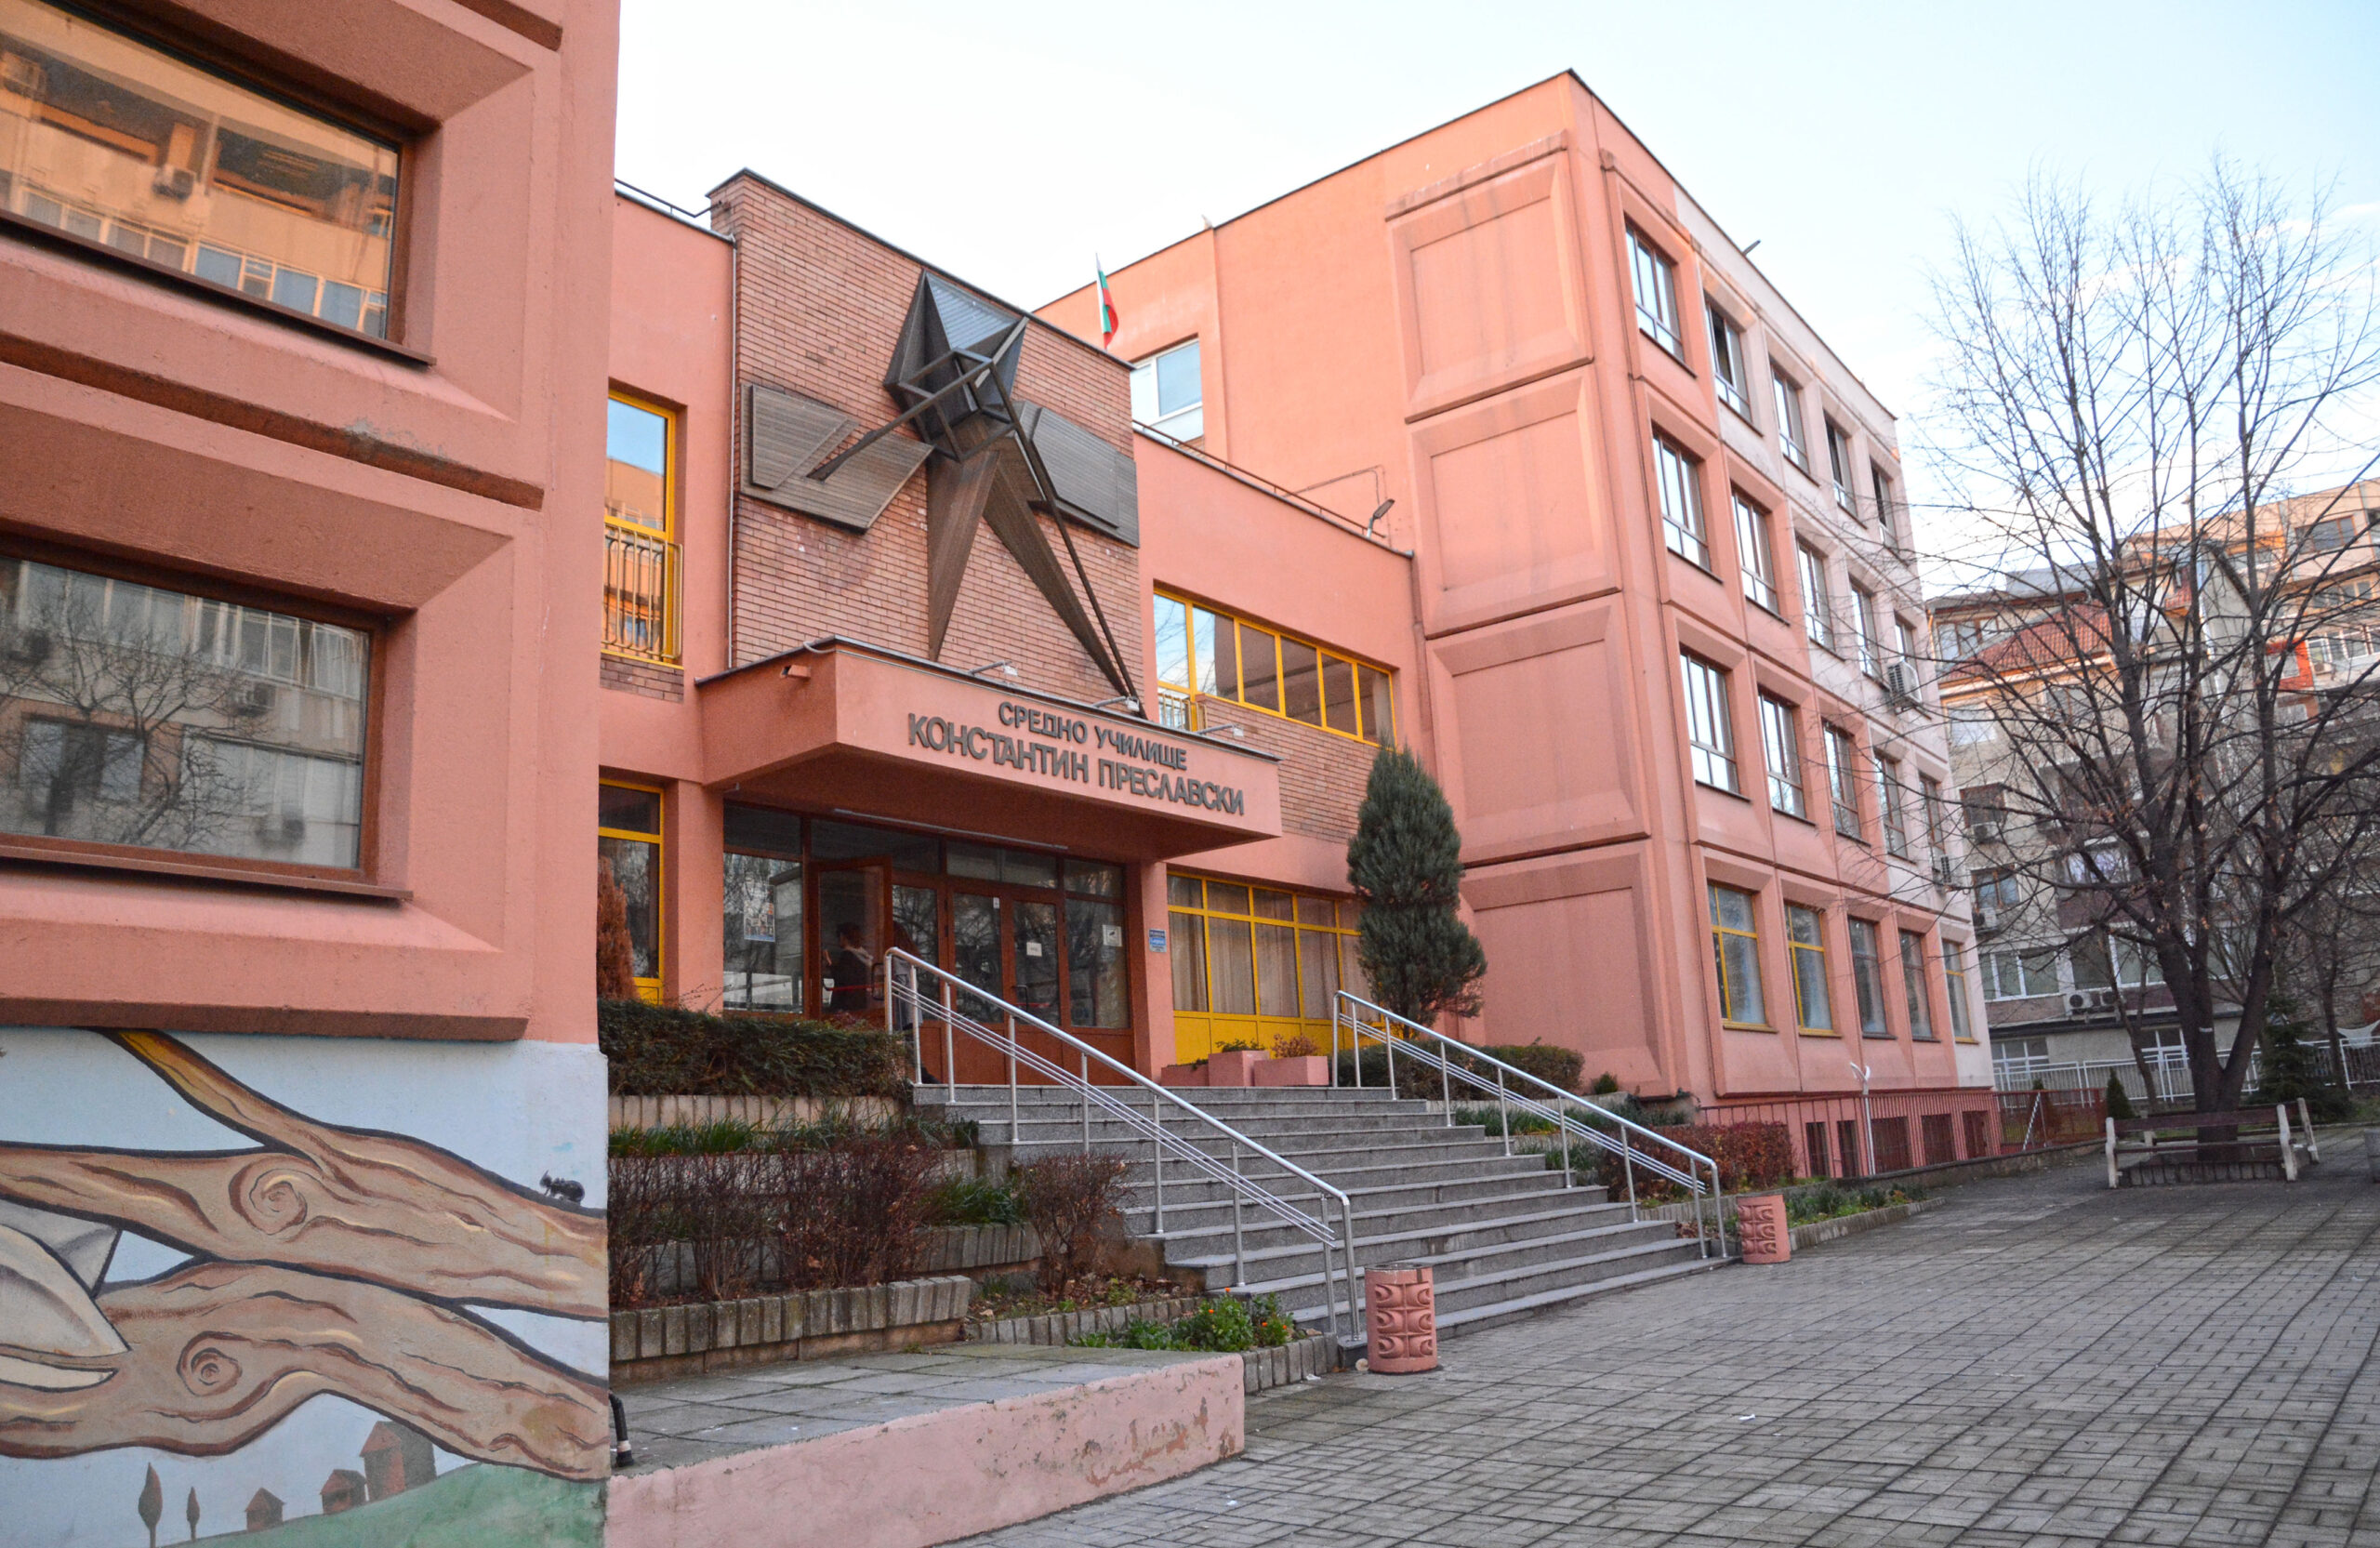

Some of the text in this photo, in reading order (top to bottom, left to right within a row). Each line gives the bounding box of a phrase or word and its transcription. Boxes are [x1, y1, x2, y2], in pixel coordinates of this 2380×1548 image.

[908, 712, 1245, 815] КОНСТАНТИН ПРЕСЛАВСКИ
[998, 701, 1188, 771] СРЕДНО УЧИЛИЩЕ
